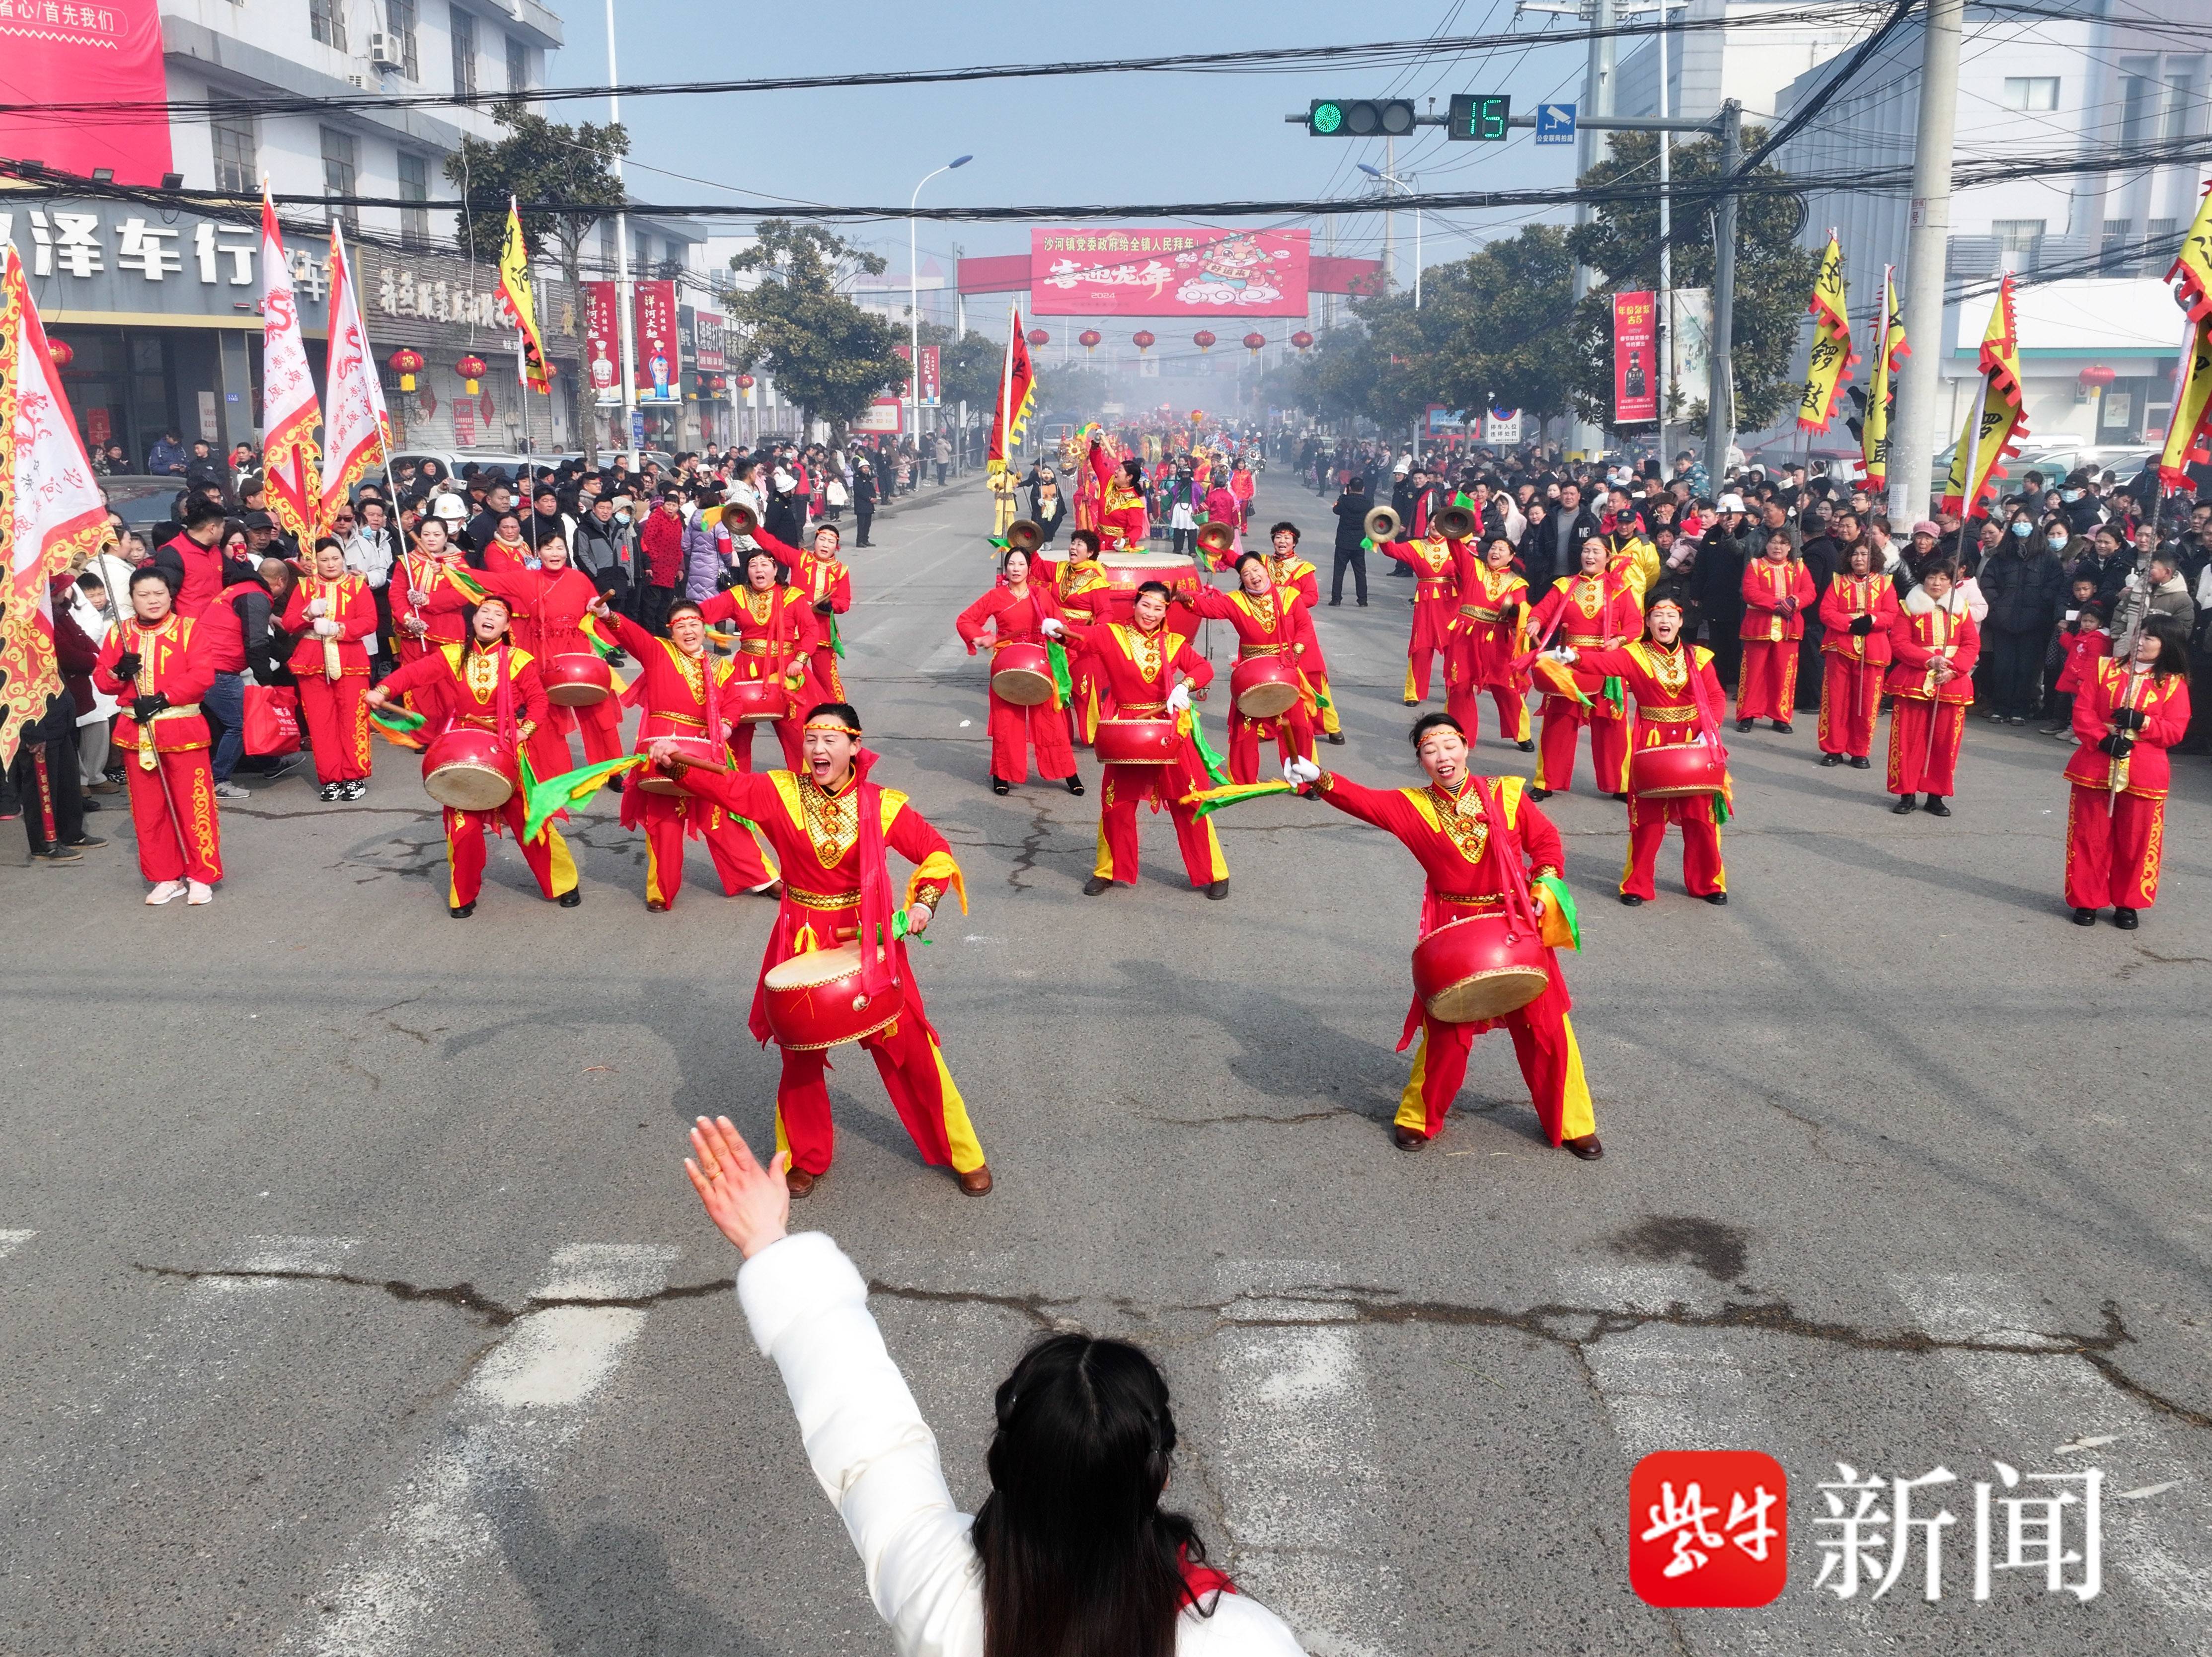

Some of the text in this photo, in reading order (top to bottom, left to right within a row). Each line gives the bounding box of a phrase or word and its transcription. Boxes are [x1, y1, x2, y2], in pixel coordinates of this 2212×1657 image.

[1471, 99, 1503, 138] 15
[0, 210, 257, 285] 泽车行
[1044, 258, 1174, 301] 喜迎龙年
[1211, 265, 1246, 276] 好运来
[1618, 304, 1650, 315] 年份原浆
[1628, 315, 1643, 324] 古5
